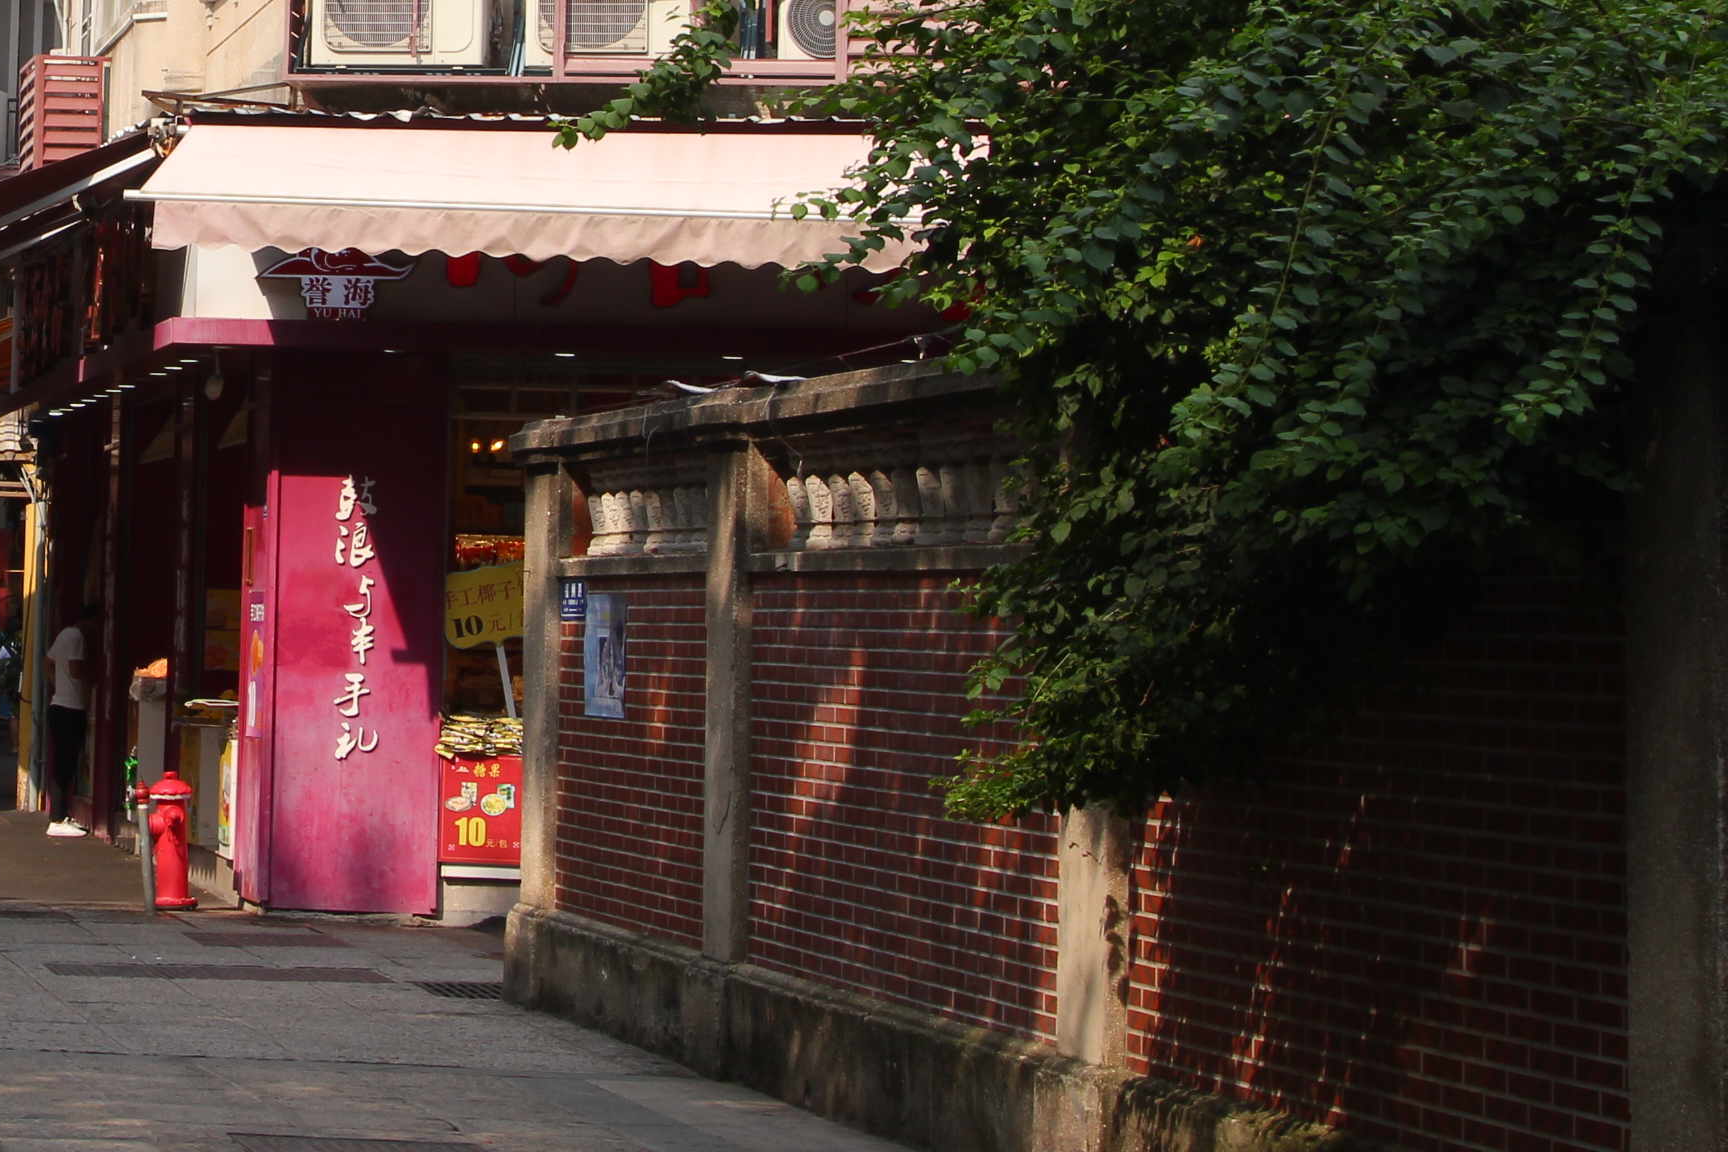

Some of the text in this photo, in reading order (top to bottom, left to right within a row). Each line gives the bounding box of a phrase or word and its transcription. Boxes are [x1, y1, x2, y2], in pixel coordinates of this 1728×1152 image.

[304, 276, 372, 306] 誉海
[314, 308, 361, 319] YU HAI
[473, 762, 501, 778] 糖果
